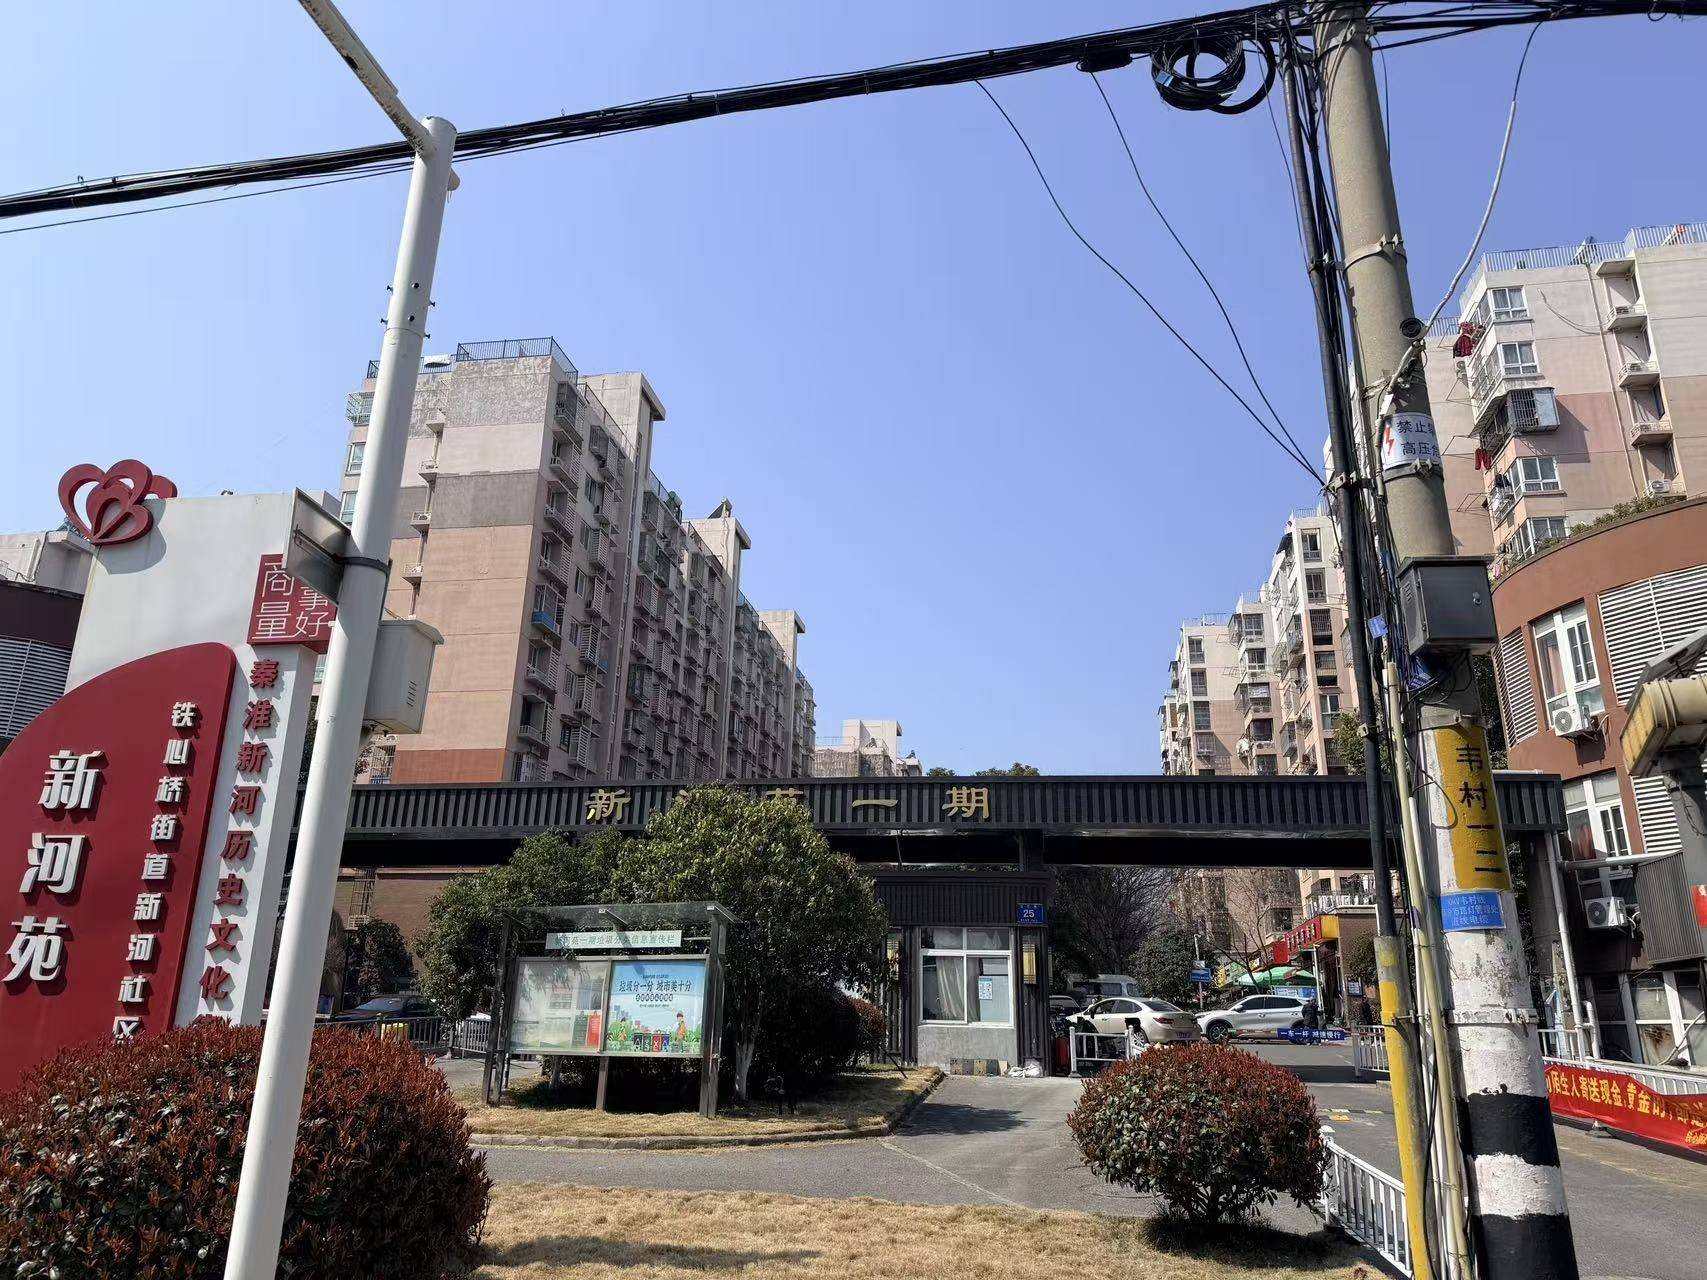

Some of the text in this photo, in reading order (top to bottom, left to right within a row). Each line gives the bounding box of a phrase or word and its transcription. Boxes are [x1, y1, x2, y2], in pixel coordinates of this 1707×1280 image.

[1, 749, 105, 982] 新河苑
[112, 701, 198, 1043] 铁心桥街道新河社区
[193, 658, 279, 1022] 秦淮新河历史文化
[584, 786, 991, 821] 新一期
[1023, 909, 1035, 918] 25
